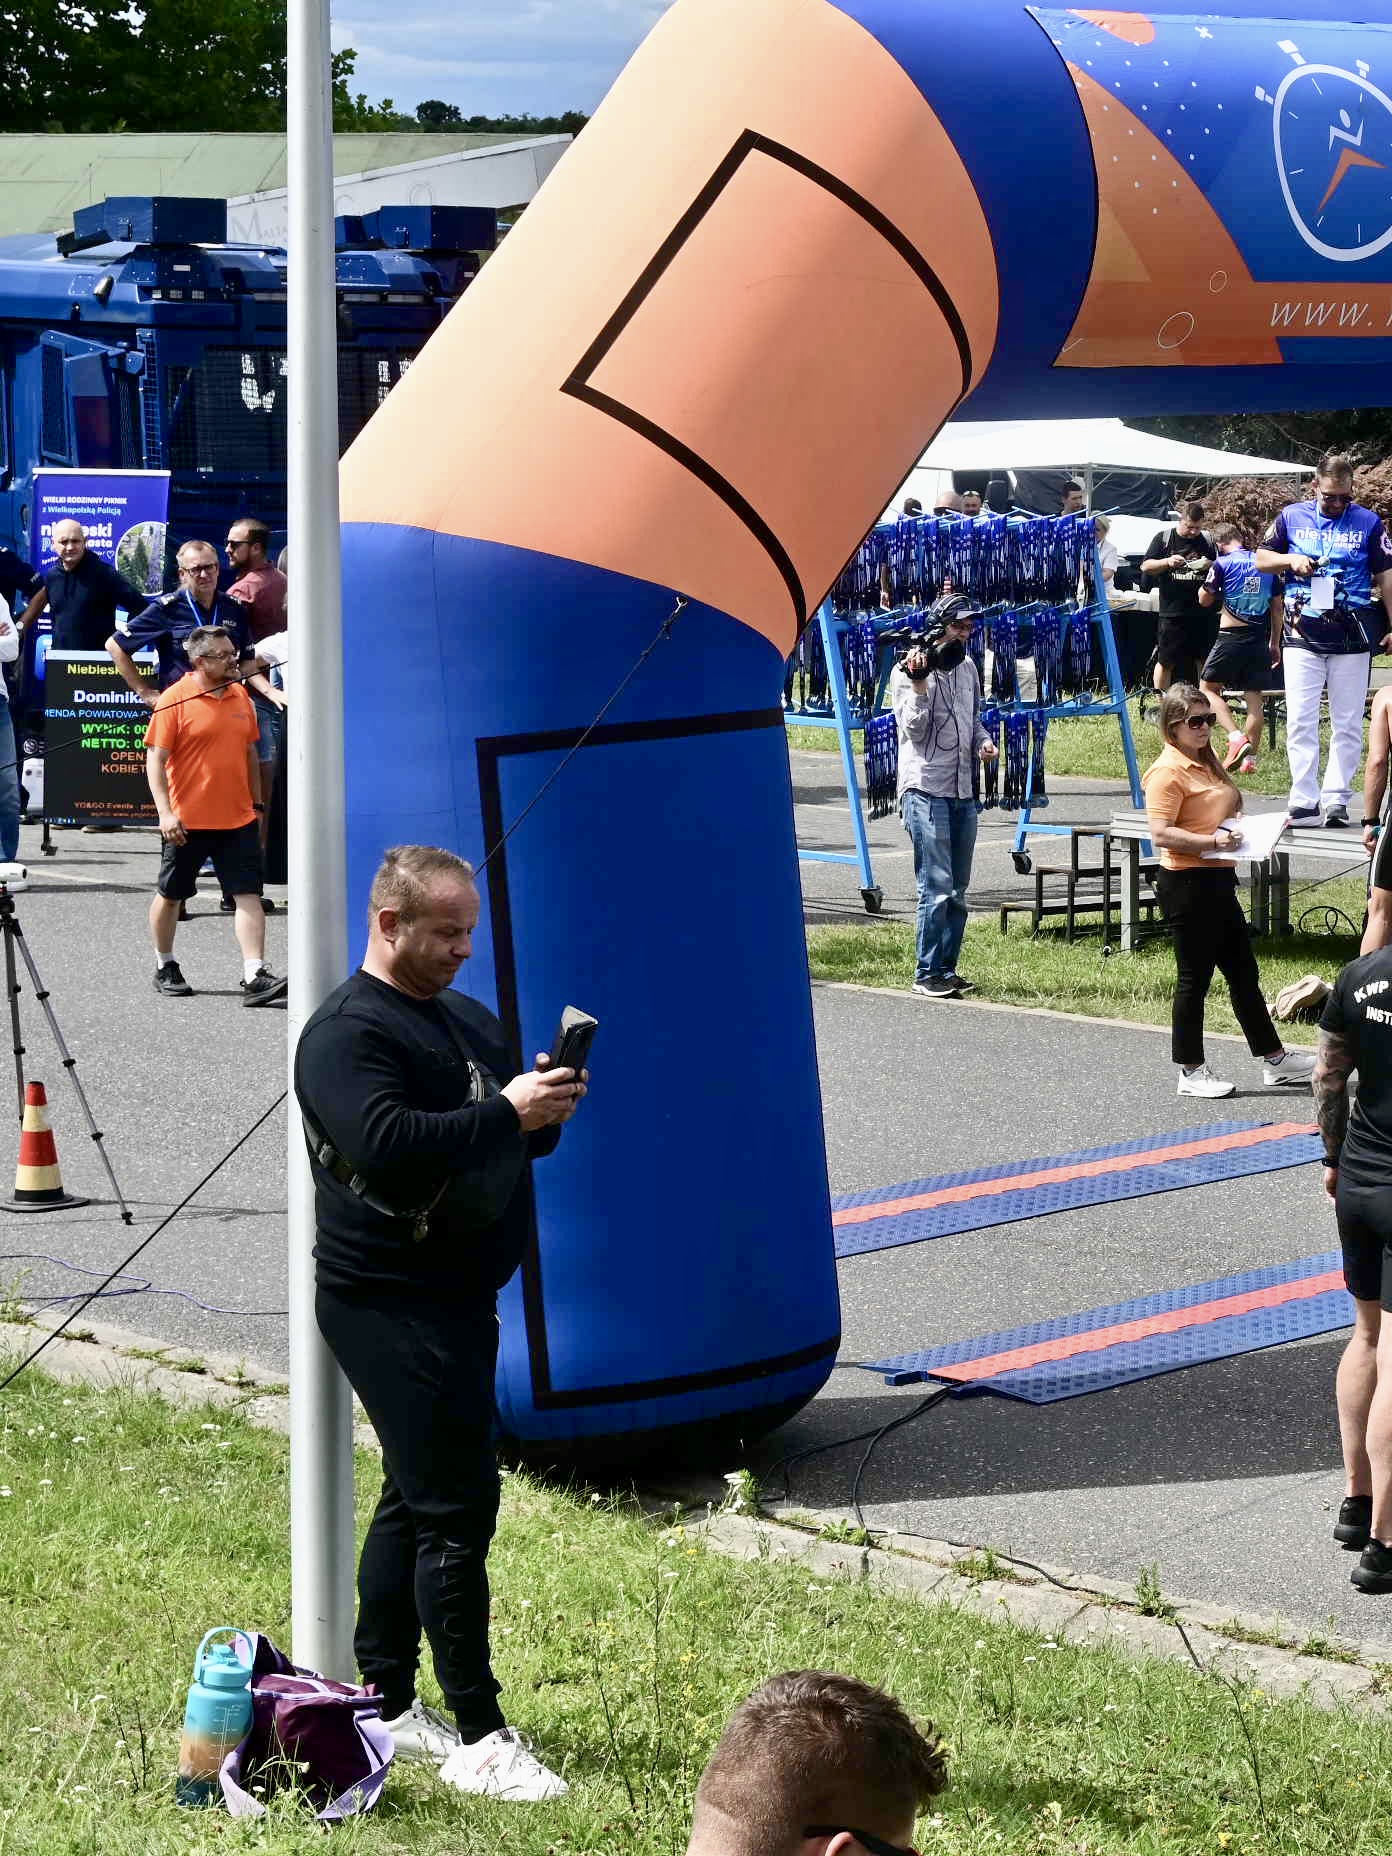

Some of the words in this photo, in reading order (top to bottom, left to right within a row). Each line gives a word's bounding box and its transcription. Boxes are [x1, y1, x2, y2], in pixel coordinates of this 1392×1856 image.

[79, 709, 138, 719] POWIATOWA
[81, 738, 131, 749] NETTO:
[1353, 980, 1389, 1003] KWP
